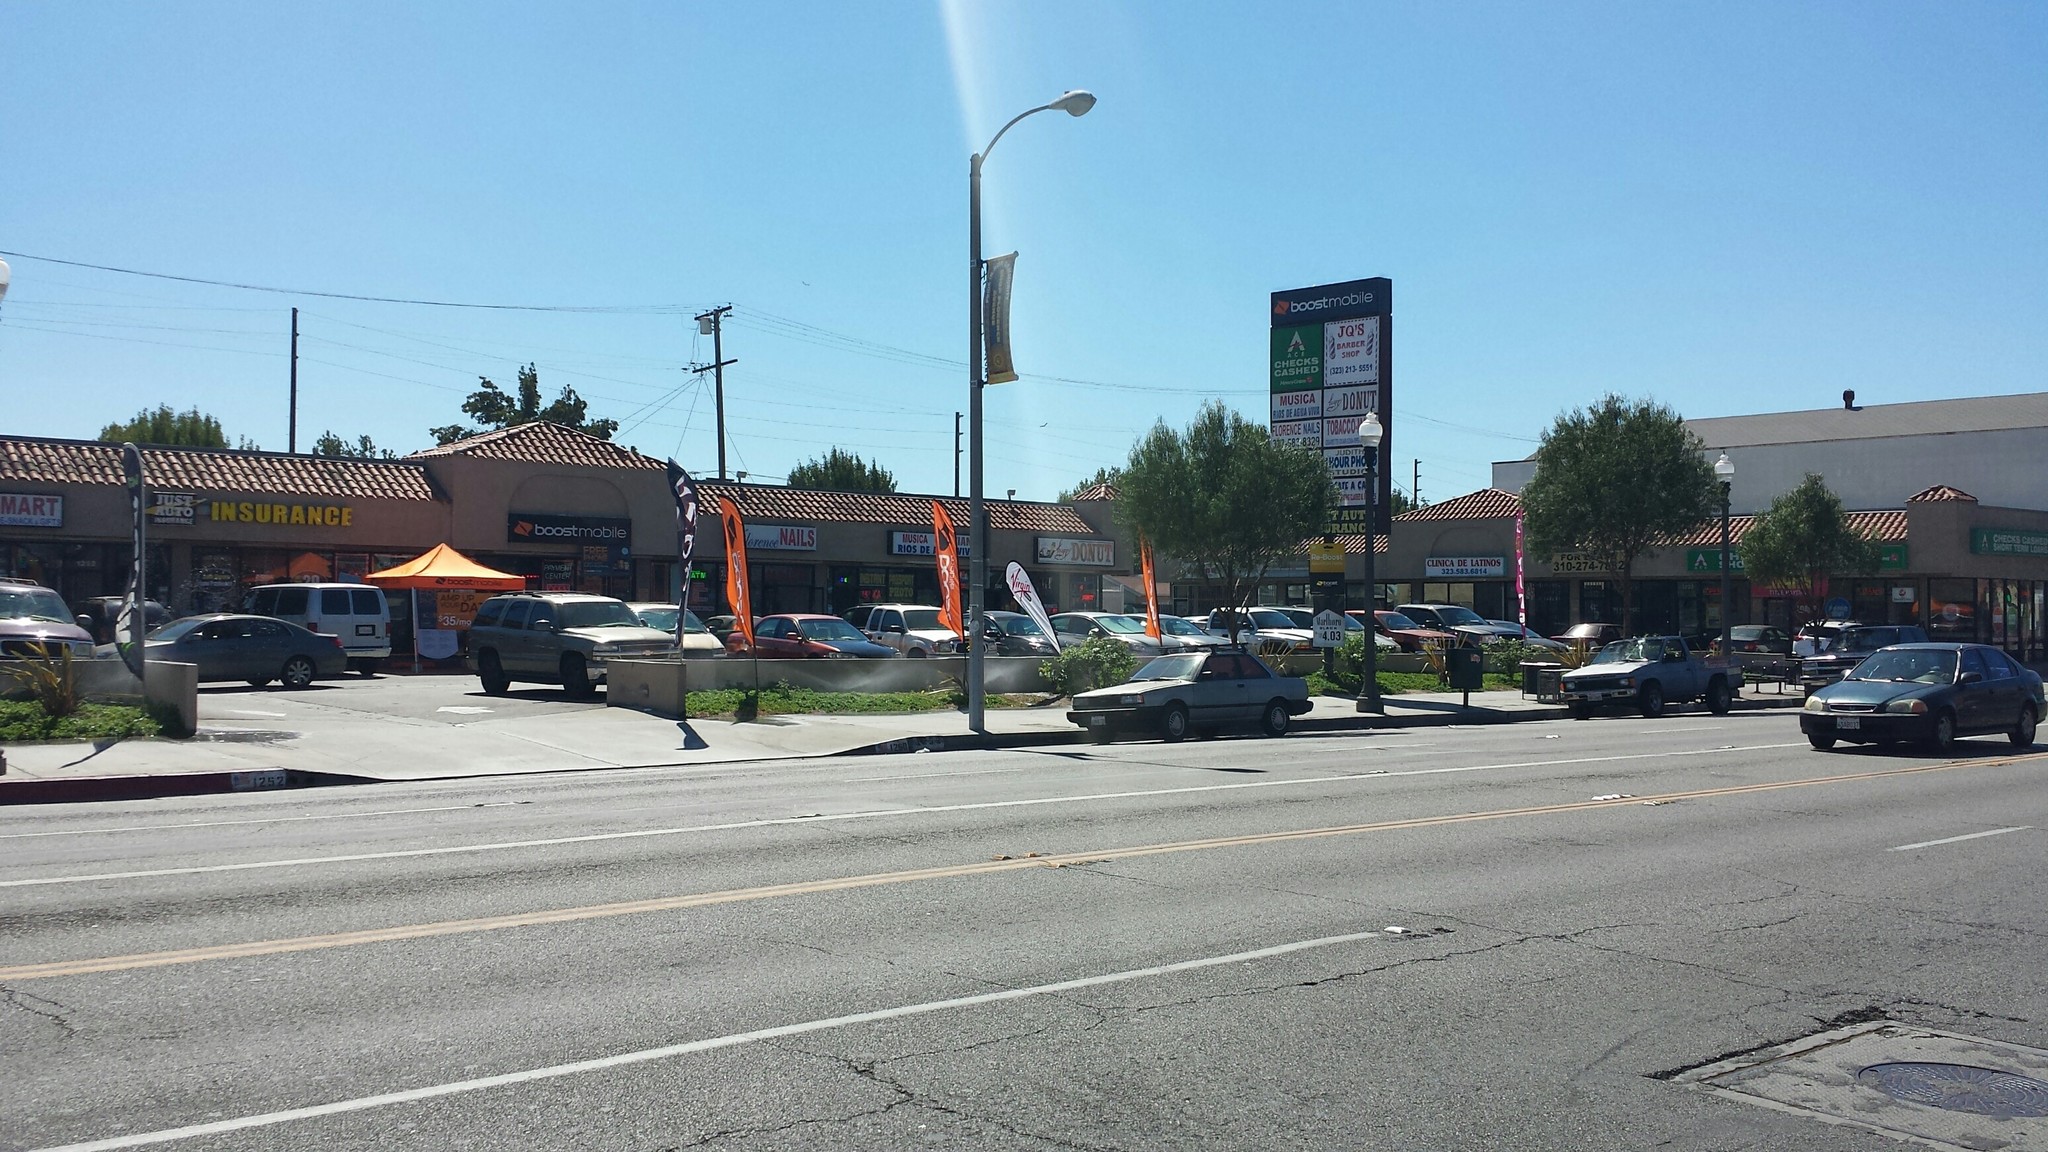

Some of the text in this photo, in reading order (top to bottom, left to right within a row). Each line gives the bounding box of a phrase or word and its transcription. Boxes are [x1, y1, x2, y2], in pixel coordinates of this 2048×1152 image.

[1290, 291, 1374, 313] boostmobile
[1337, 323, 1365, 338] JQ'S
[1336, 340, 1365, 350] BARBER
[1341, 350, 1360, 359] SHOP
[1274, 357, 1319, 369] CHECKS
[1274, 366, 1319, 377] CASHED
[1329, 367, 1344, 375] (323)
[1358, 364, 1373, 373] 5551
[1279, 393, 1316, 407] MUSICA
[1342, 390, 1377, 412] DONUT
[1286, 408, 1293, 418] DE
[1272, 421, 1320, 437] FLORENCE NAILS
[1, 496, 59, 516] MART
[156, 494, 194, 506] JUST
[154, 505, 194, 517] AUTO
[211, 501, 353, 527] INSURANCE
[1341, 509, 1366, 521] AUT
[534, 523, 627, 539] boostmobile
[744, 527, 815, 548] lorence NAILS
[902, 533, 928, 544] MUSICA
[1993, 534, 2048, 545] CHECKS CASHED
[583, 546, 608, 555] FREE
[897, 544, 917, 554] RIOS
[920, 545, 931, 554] DE
[1072, 542, 1113, 563] DONUT
[1993, 543, 2013, 552] SHORT
[1311, 553, 1343, 561] Re-Boost
[1427, 559, 1501, 567] CLINICA DE LATINOS
[1010, 567, 1031, 593] Virgin
[440, 594, 460, 602] AMP
[461, 594, 475, 602] UP
[1322, 631, 1341, 641] 4.03
[253, 776, 284, 788] 1252
